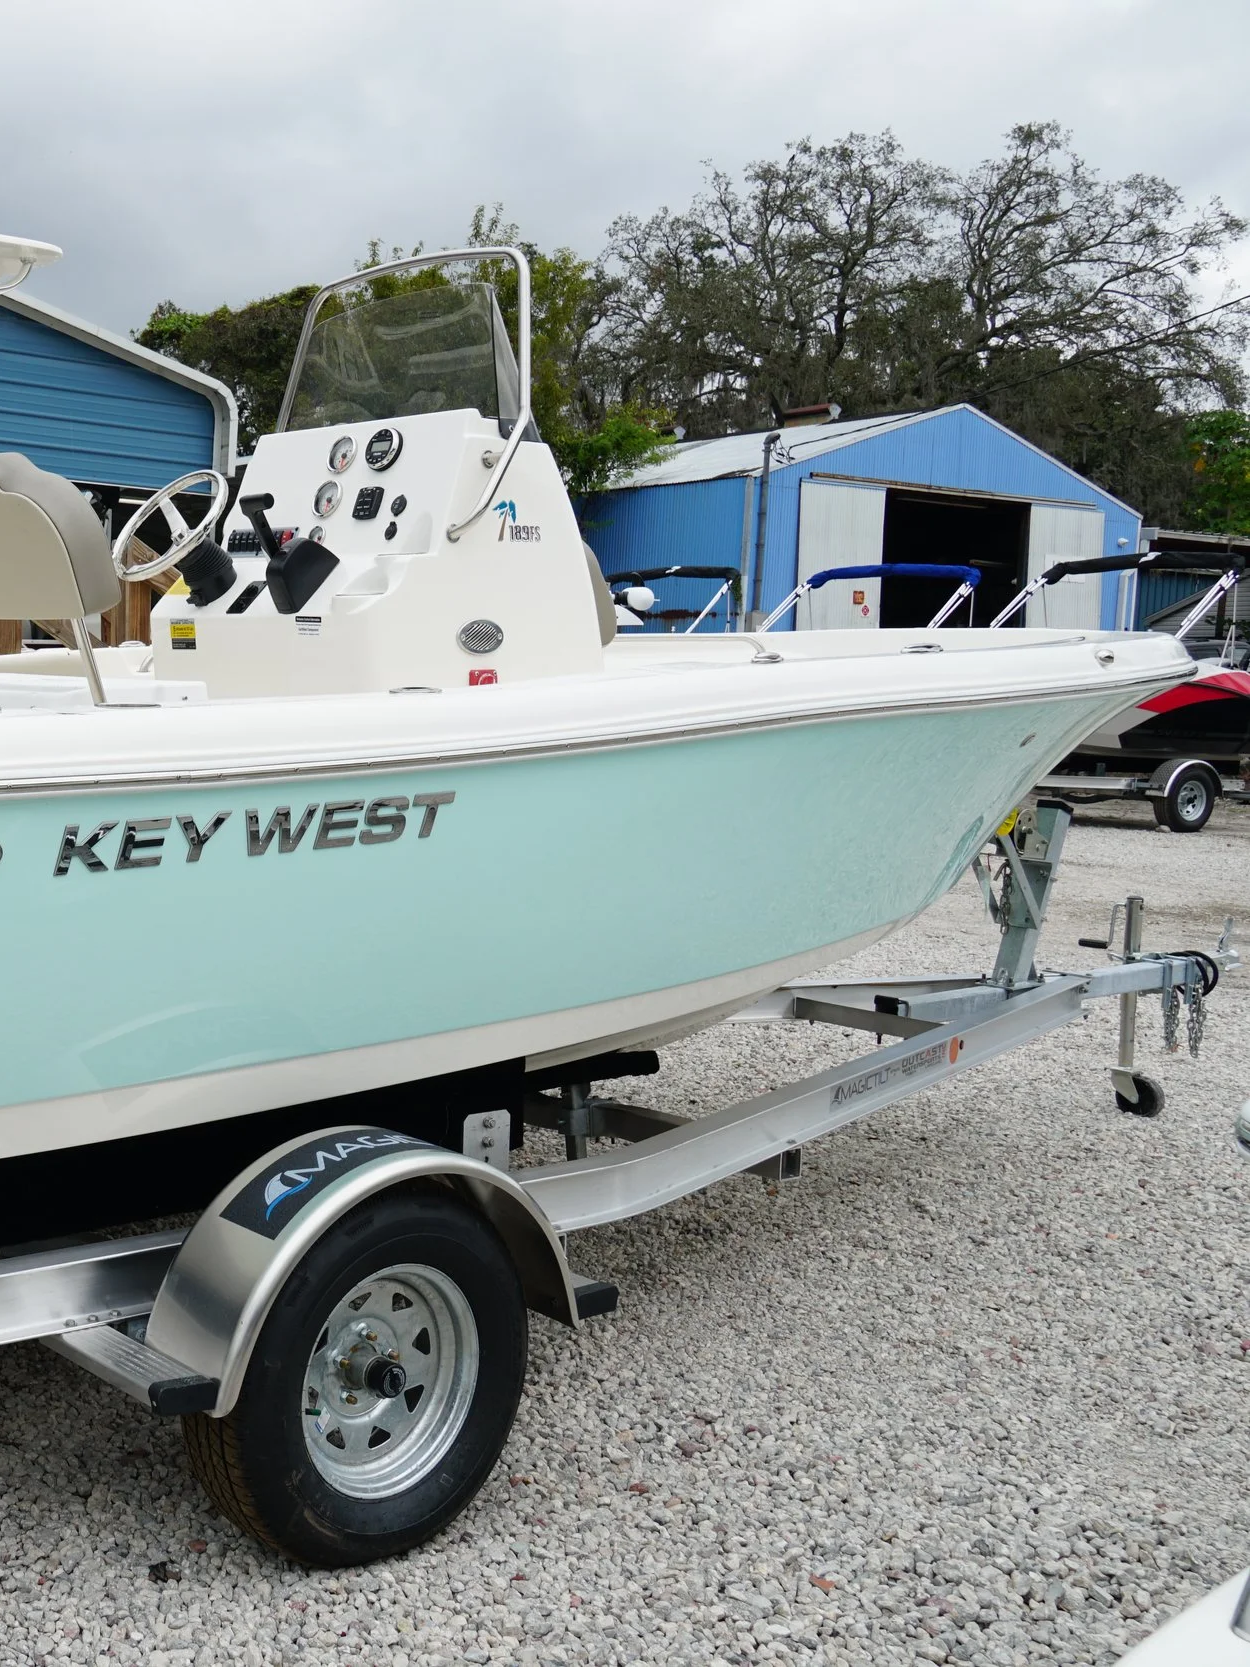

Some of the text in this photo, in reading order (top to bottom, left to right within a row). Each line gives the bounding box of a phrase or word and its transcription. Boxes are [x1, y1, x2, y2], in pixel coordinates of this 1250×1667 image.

[508, 525, 541, 542] 189FS
[53, 791, 456, 877] KEY WEST
